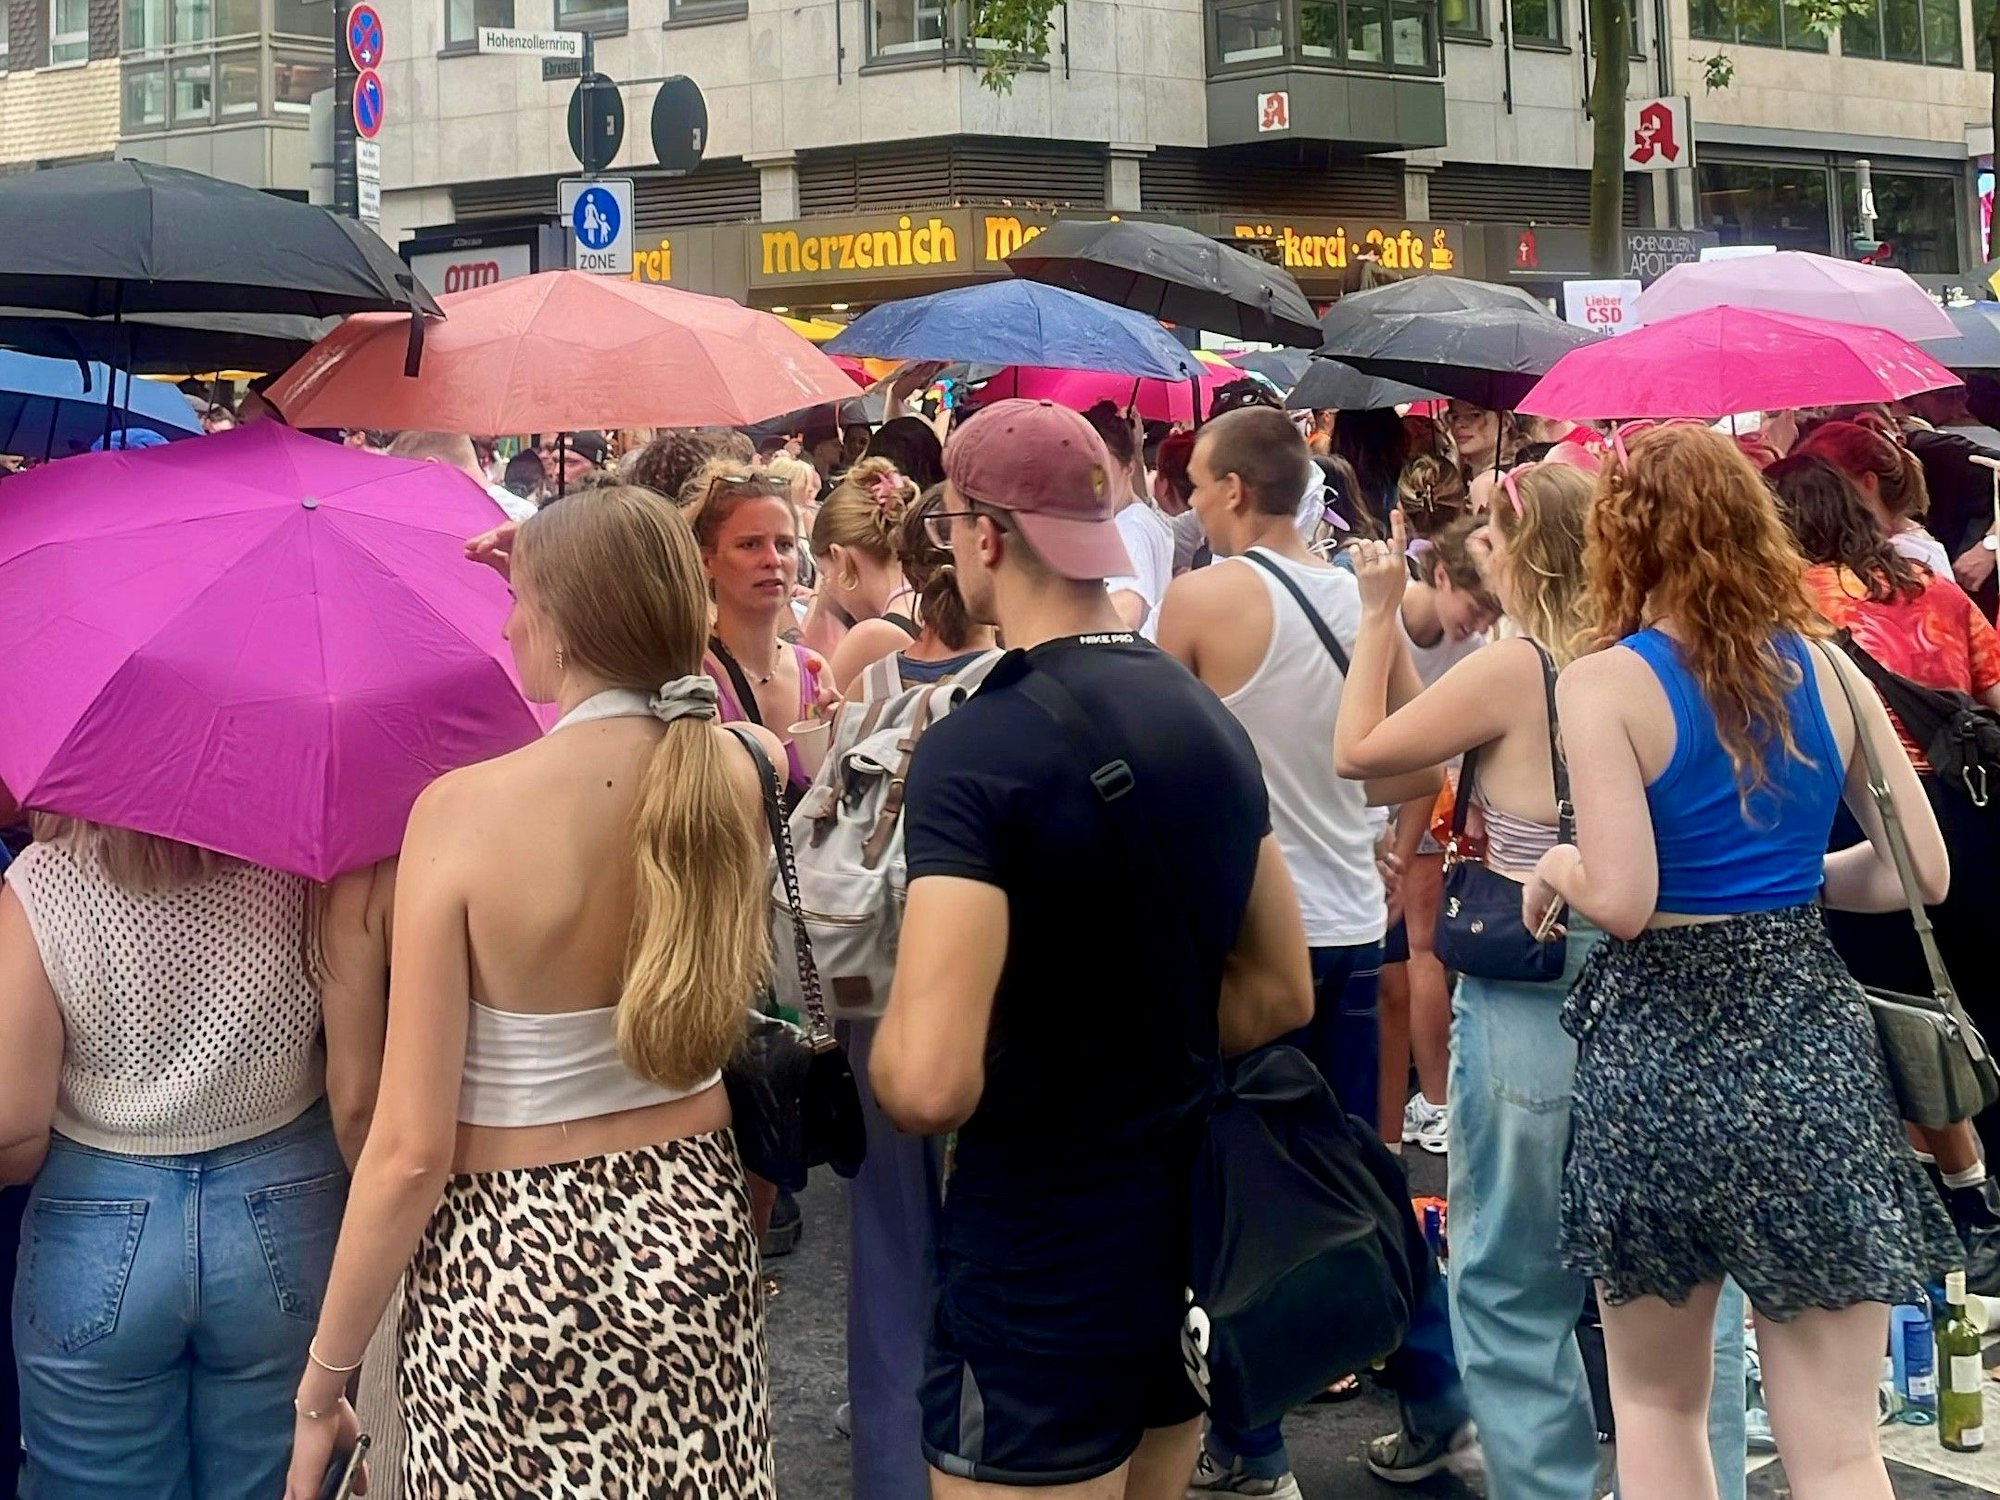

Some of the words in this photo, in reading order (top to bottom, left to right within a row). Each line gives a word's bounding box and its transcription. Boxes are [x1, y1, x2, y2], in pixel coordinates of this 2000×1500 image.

[486, 31, 577, 54] Hohenzollernring
[761, 215, 957, 275] Merzenich
[1235, 225, 1347, 268] kerei
[580, 254, 616, 269] ZONE
[445, 261, 499, 294] OTTO
[1584, 295, 1622, 307] Lieber
[1587, 307, 1622, 324] CSD
[1079, 635, 1111, 645] NIKE
[1111, 633, 1135, 644] PRO
